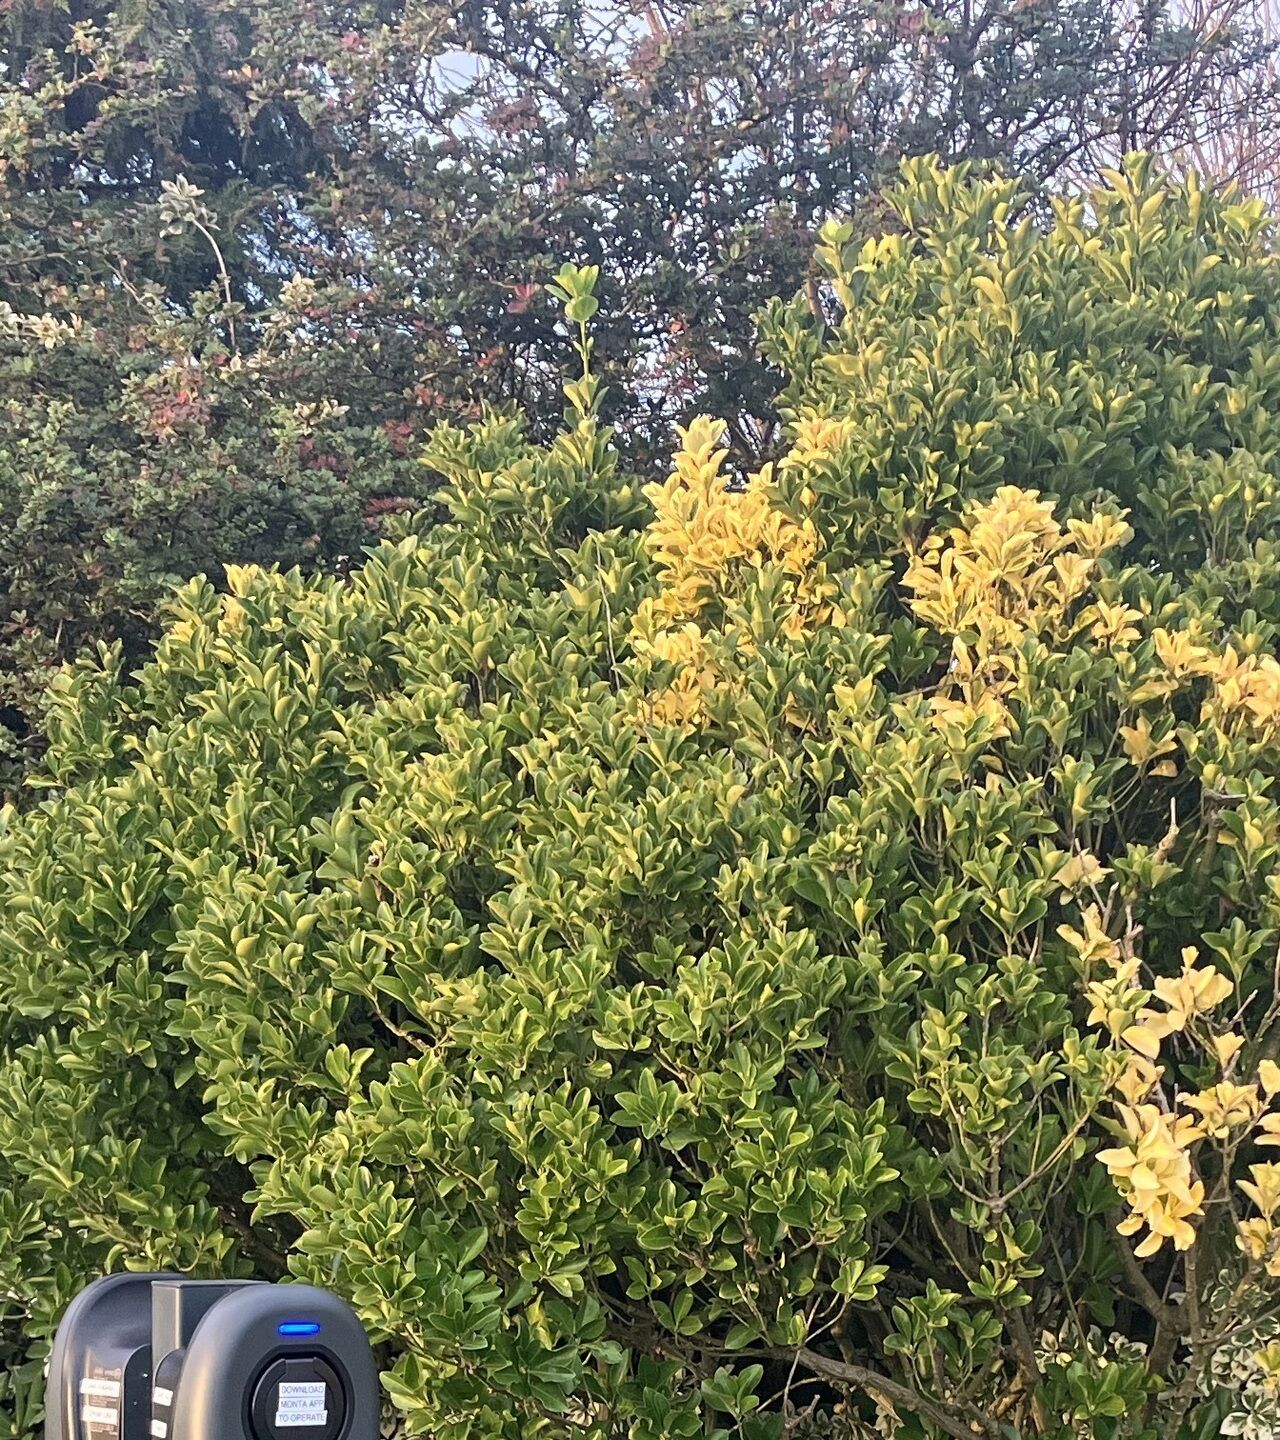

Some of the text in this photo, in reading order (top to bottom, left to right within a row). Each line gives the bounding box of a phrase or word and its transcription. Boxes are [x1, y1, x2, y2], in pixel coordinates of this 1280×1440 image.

[281, 1386, 324, 1394] DOWNLOAD
[280, 1400, 324, 1408] MONTA APP
[279, 1413, 326, 1422] TO OPERATE
